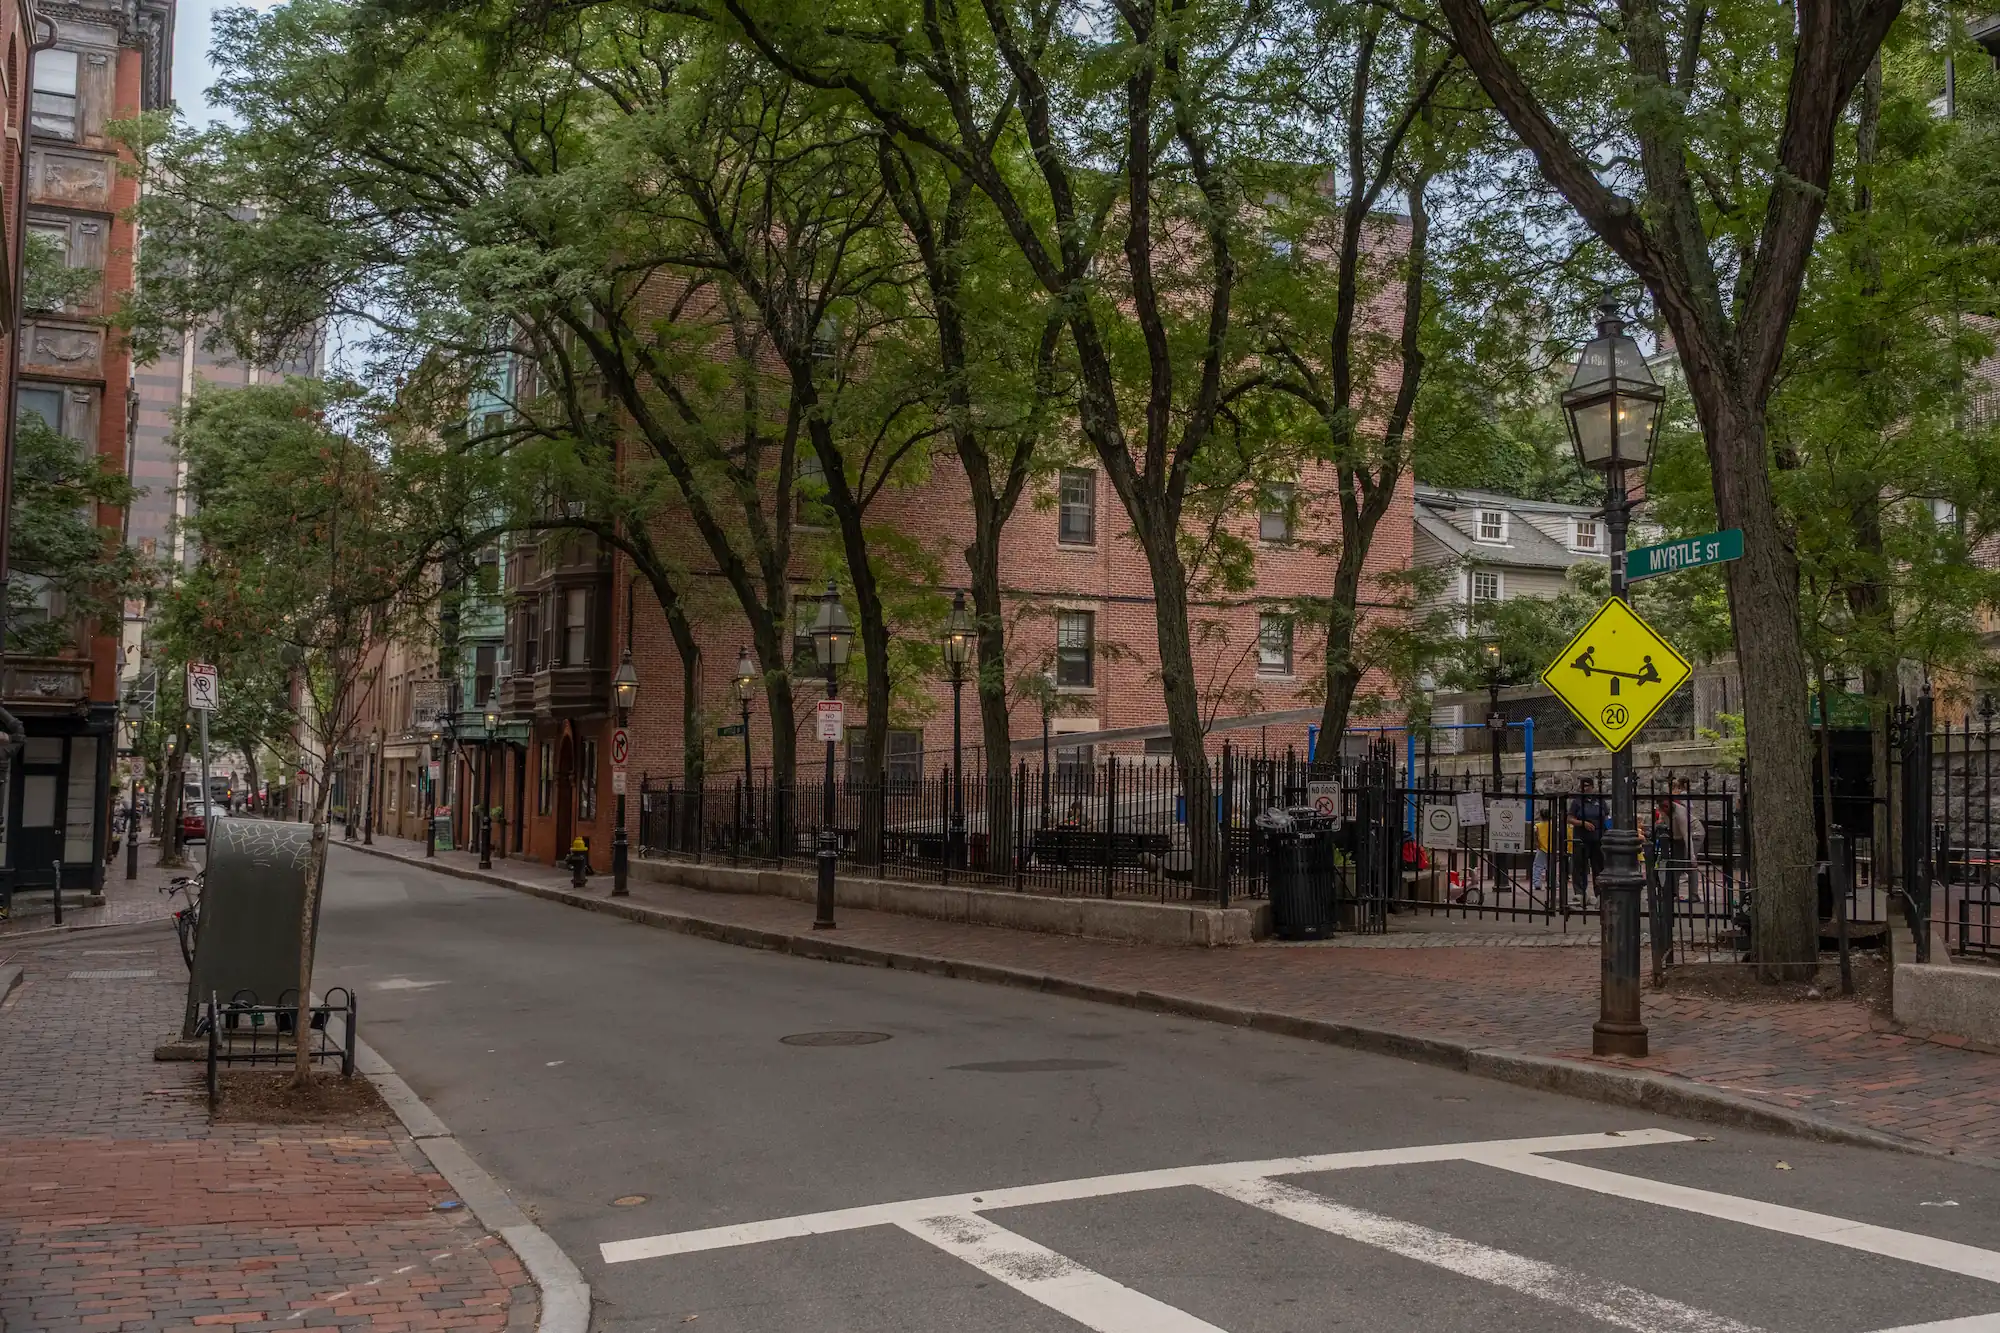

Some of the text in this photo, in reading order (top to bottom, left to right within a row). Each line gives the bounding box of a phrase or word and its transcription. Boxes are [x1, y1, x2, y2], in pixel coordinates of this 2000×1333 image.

[1649, 541, 1720, 570] MYRTLE ST
[1606, 708, 1625, 724] 20
[1311, 785, 1337, 794] NO DOGS
